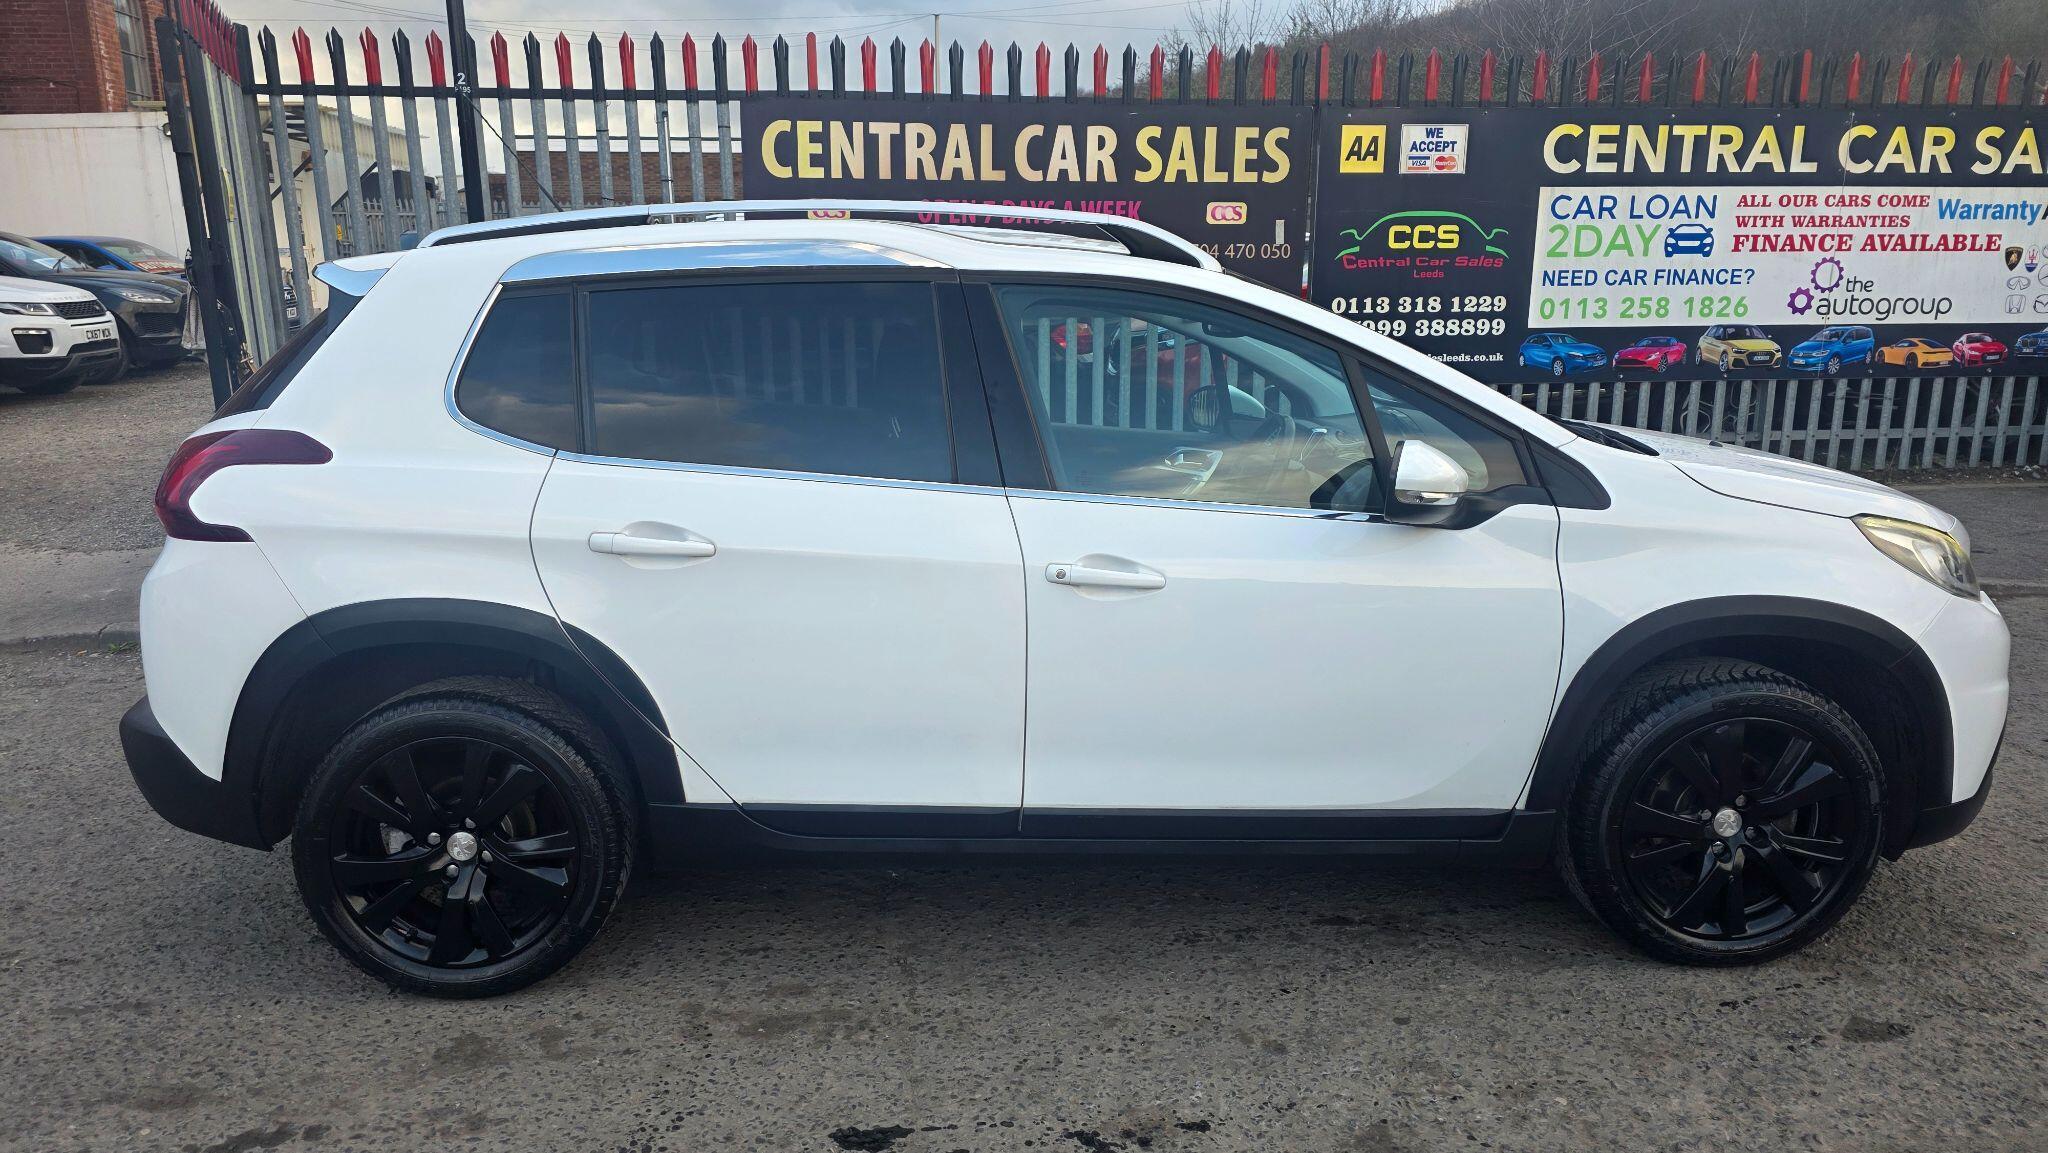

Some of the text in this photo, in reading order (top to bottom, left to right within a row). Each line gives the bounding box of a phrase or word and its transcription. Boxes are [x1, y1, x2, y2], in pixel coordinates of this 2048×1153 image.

[1425, 127, 1444, 139] WE
[762, 120, 1291, 184] CENTRAL CAR SALES
[1345, 135, 1379, 162] AA
[1409, 140, 1458, 153] ACCEPT
[1543, 123, 2048, 175] CENTRAL CAR SA
[1550, 194, 1718, 220] CAR LOAN
[1736, 194, 1931, 208] ALL OUR CARS COME
[1210, 205, 1243, 221] CCS
[1735, 215, 1911, 228] WITH WARRANTIES
[1388, 224, 1460, 249] CCS
[1546, 223, 1662, 258] 2DAY
[1731, 234, 2003, 252] FINANCE AVAILABLE
[1192, 243, 1291, 259] 04 470 050
[1342, 255, 1504, 269] Central Car Sales
[1413, 268, 1445, 279] Leeds
[1542, 268, 1756, 287] NEED CAR FINANCE?
[1846, 275, 1875, 293] the
[1331, 295, 1508, 314] 0113 318 1229
[1539, 295, 1749, 320] 0113 258 1826
[1815, 295, 1953, 321] autogroup
[1352, 318, 1506, 337] 999 388899
